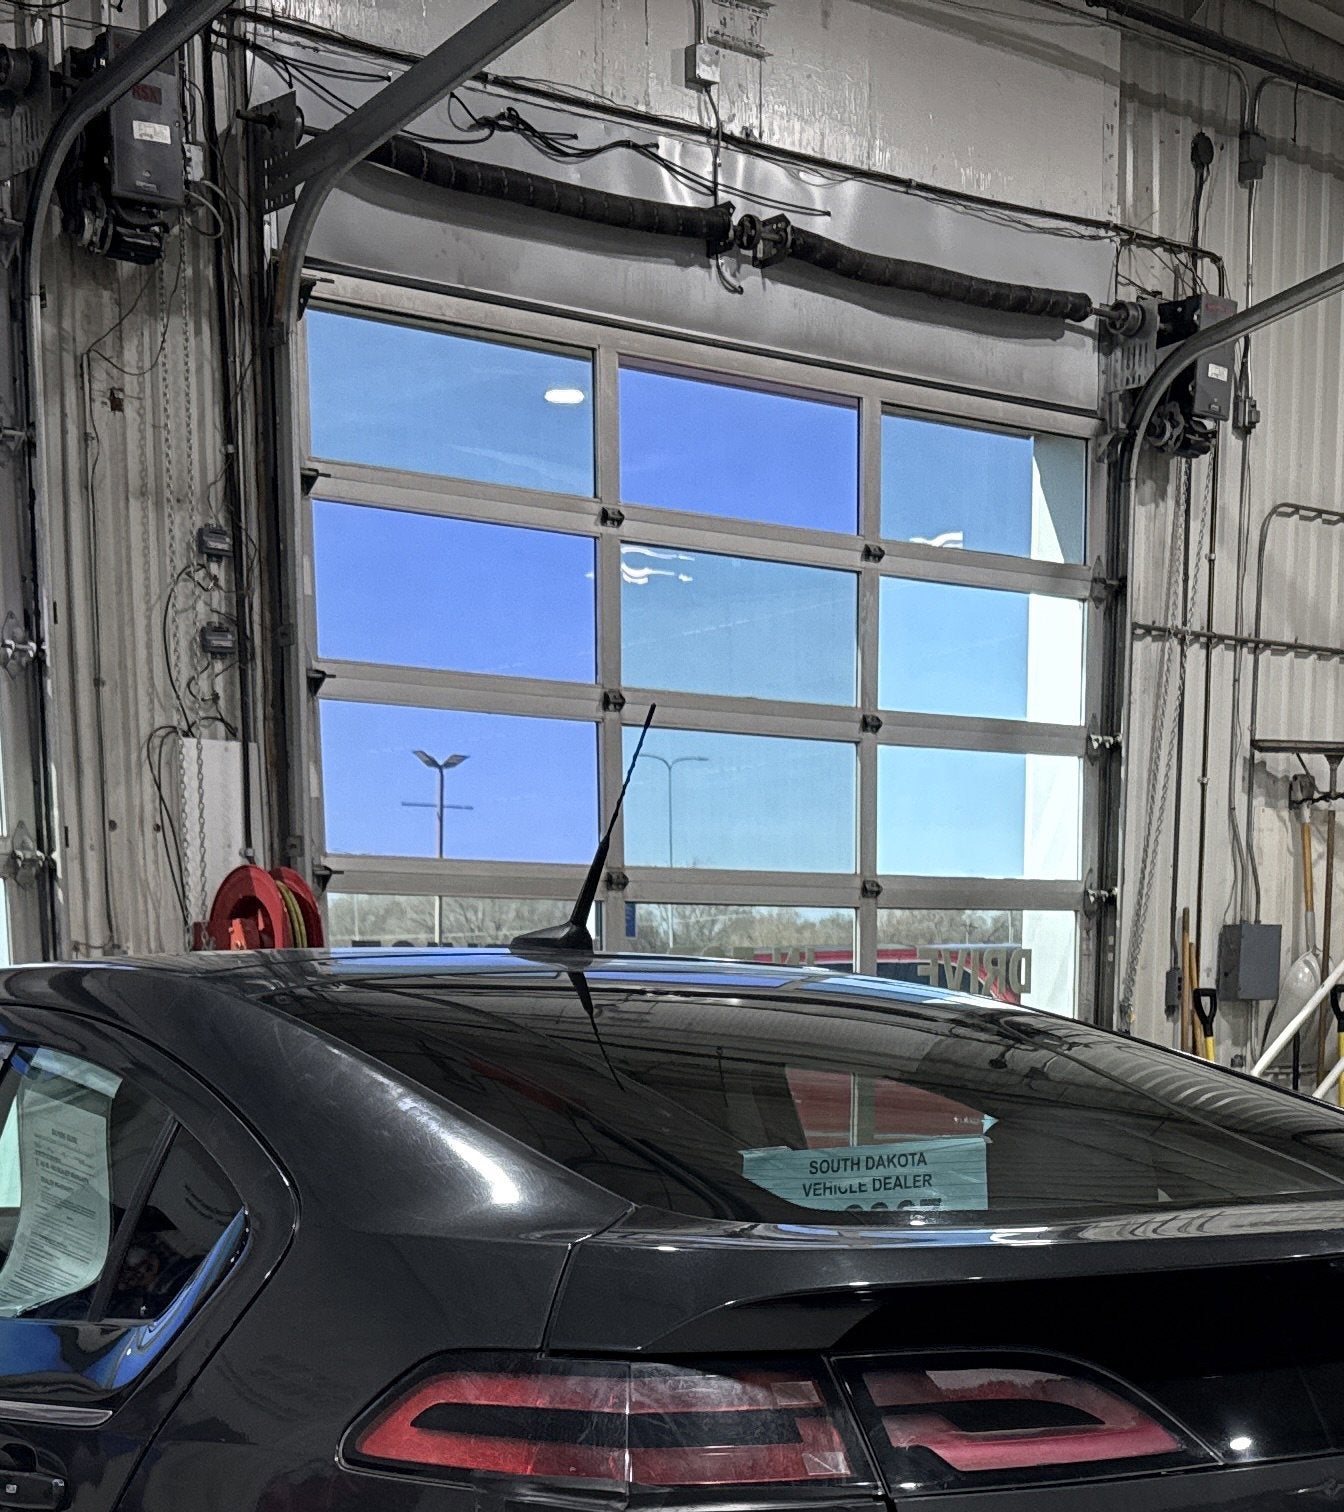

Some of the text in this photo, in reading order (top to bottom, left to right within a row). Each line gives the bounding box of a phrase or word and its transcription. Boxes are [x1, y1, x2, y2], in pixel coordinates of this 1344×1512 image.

[808, 1151, 928, 1175] SOUTH DAKOTA
[802, 1173, 933, 1198] VEHICLE DEALER
